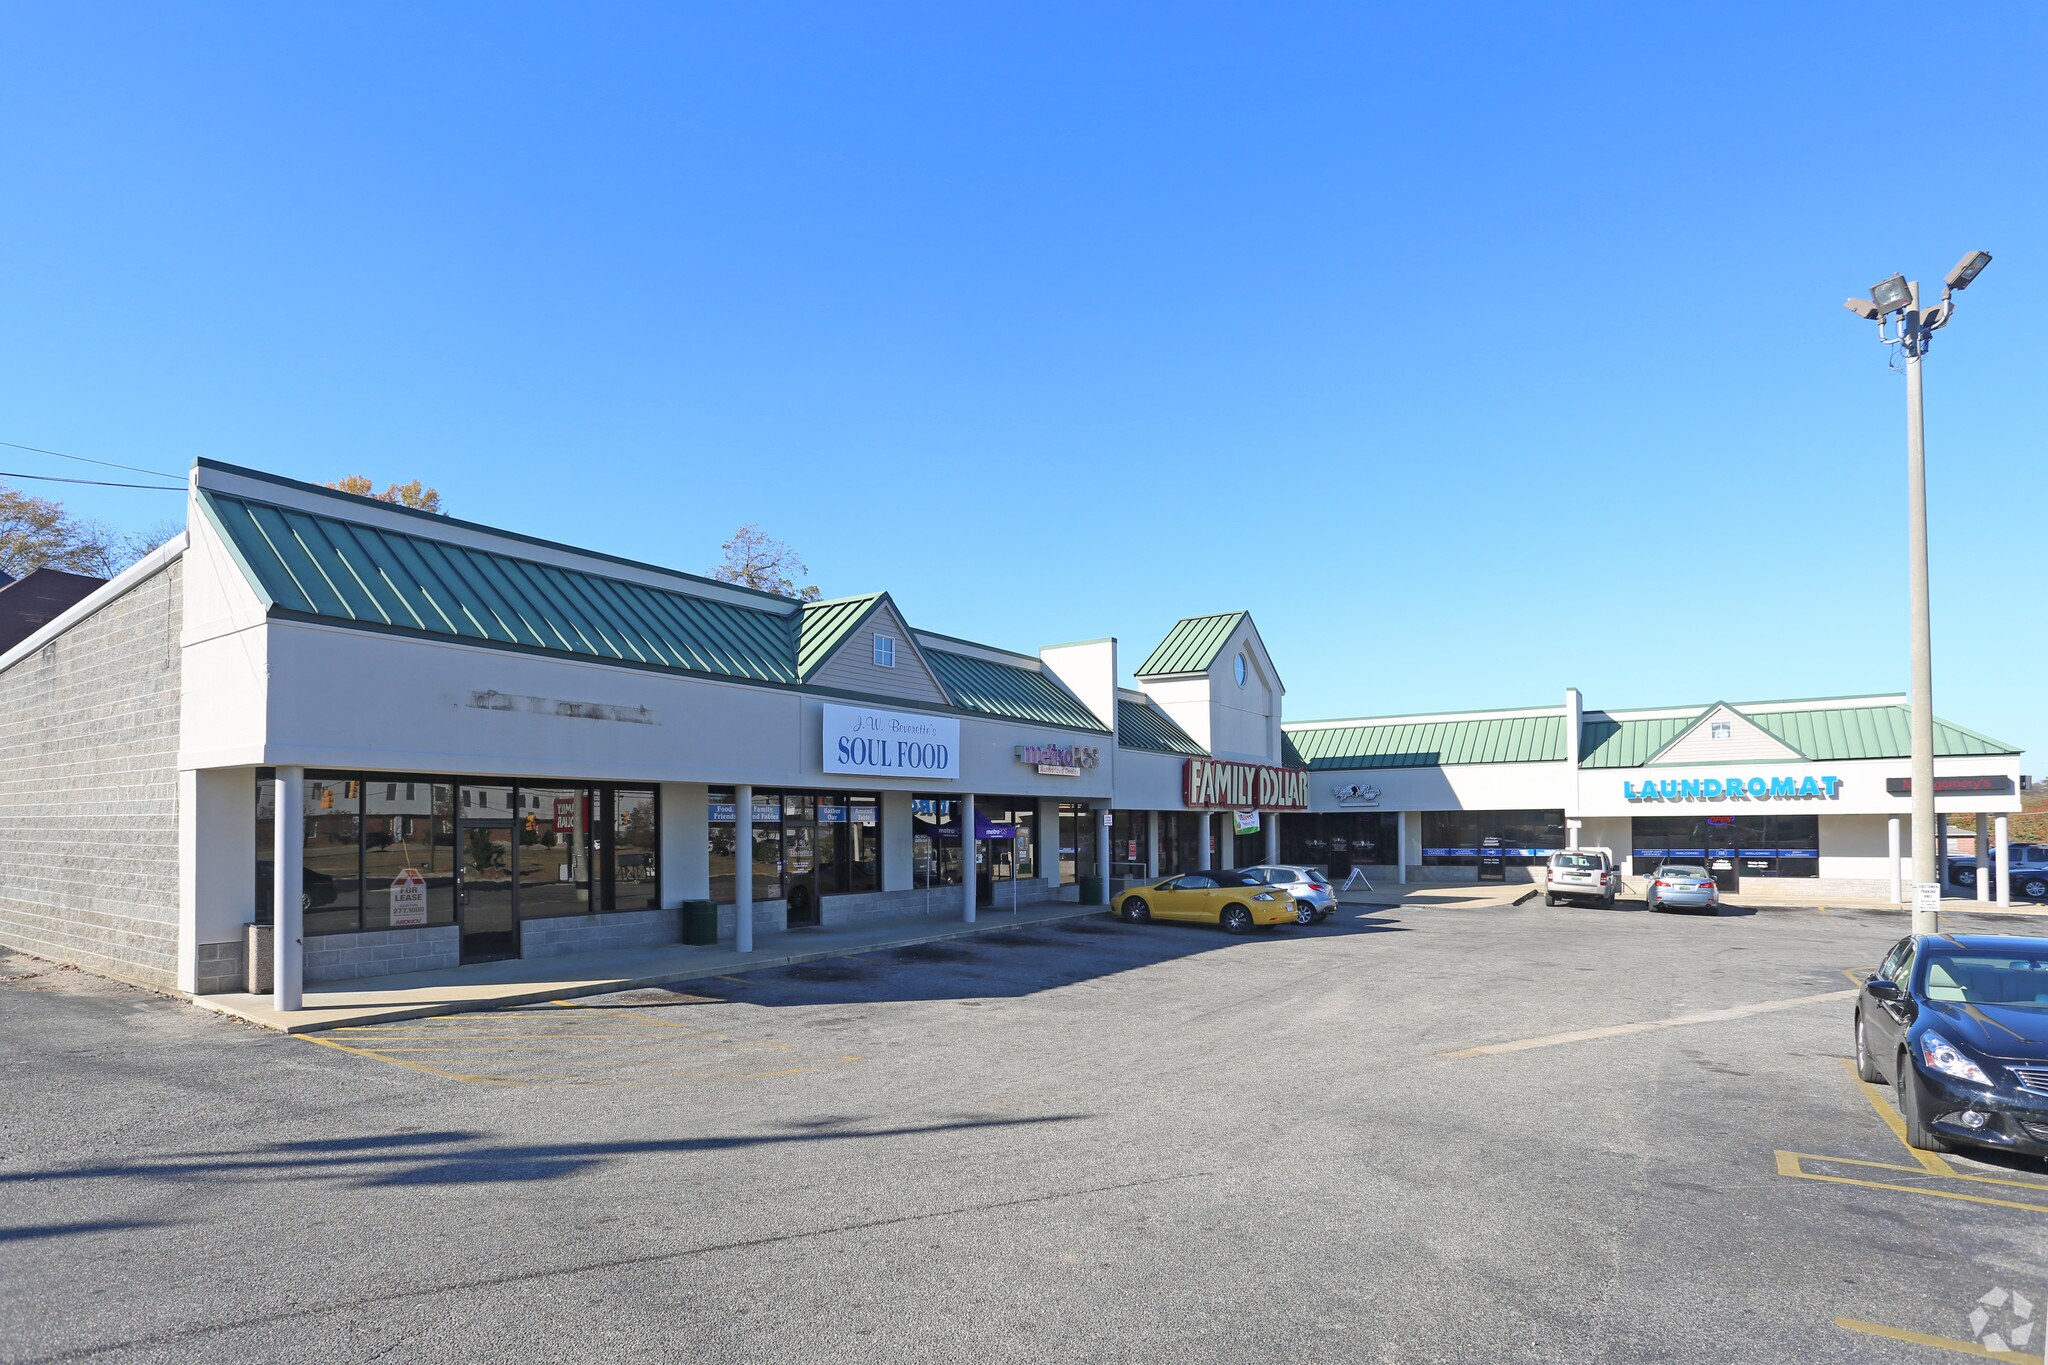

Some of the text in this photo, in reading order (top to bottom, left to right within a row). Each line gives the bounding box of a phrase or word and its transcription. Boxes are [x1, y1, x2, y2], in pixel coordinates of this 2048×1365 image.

[888, 719, 937, 736] Beverette's
[838, 735, 949, 770] SOUL FOOD
[1024, 744, 1099, 769] metroPCS
[1191, 760, 1309, 806] FAMILY DOLLAR
[1624, 776, 1837, 798] LAUNDROMAT
[1903, 778, 1992, 791] Mgomery's
[395, 894, 423, 902] LEASE
[400, 886, 418, 894] FOR
